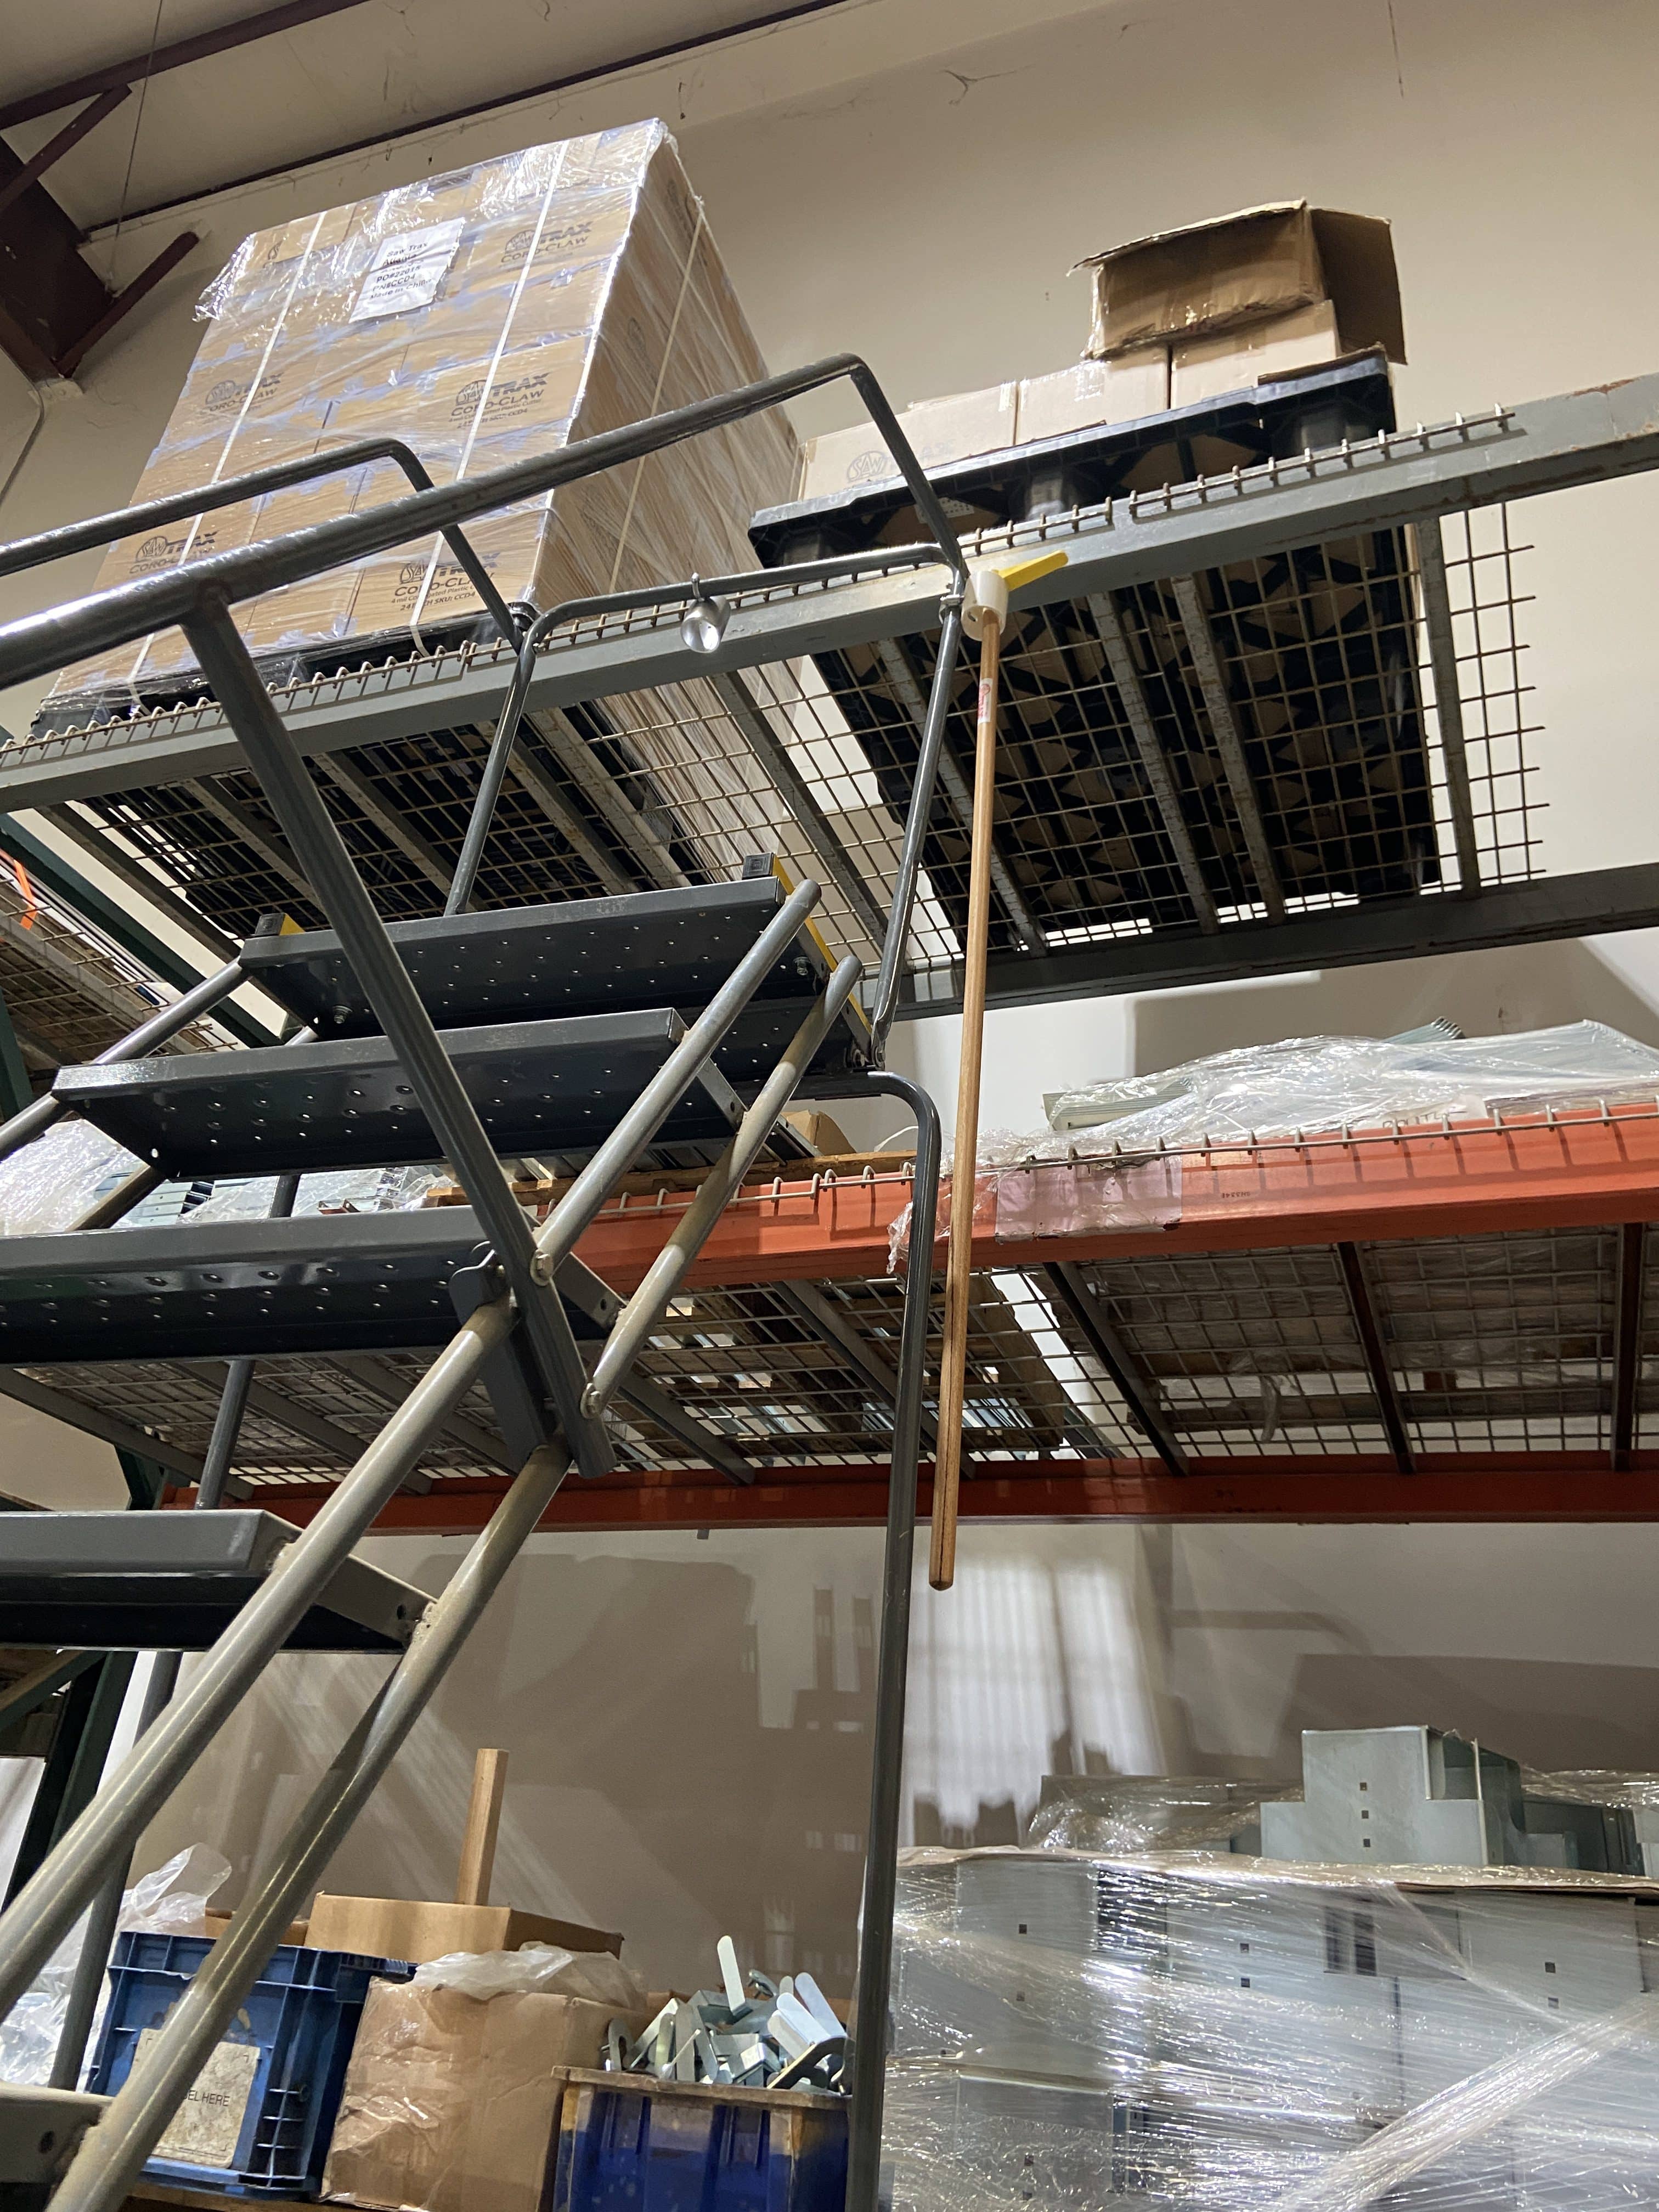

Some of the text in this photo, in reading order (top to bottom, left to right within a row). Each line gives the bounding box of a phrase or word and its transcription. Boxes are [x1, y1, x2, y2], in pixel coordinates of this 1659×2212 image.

[387, 242, 428, 257] Saw Trax
[492, 373, 550, 396] TRAX
[848, 452, 886, 481] SAW
[137, 536, 166, 561] SAW
[437, 552, 500, 577] TRX
[433, 596, 453, 605] SKU:
[454, 591, 476, 601] CCD4
[448, 585, 468, 594] Plastic
[202, 2092, 230, 2107] HERE
